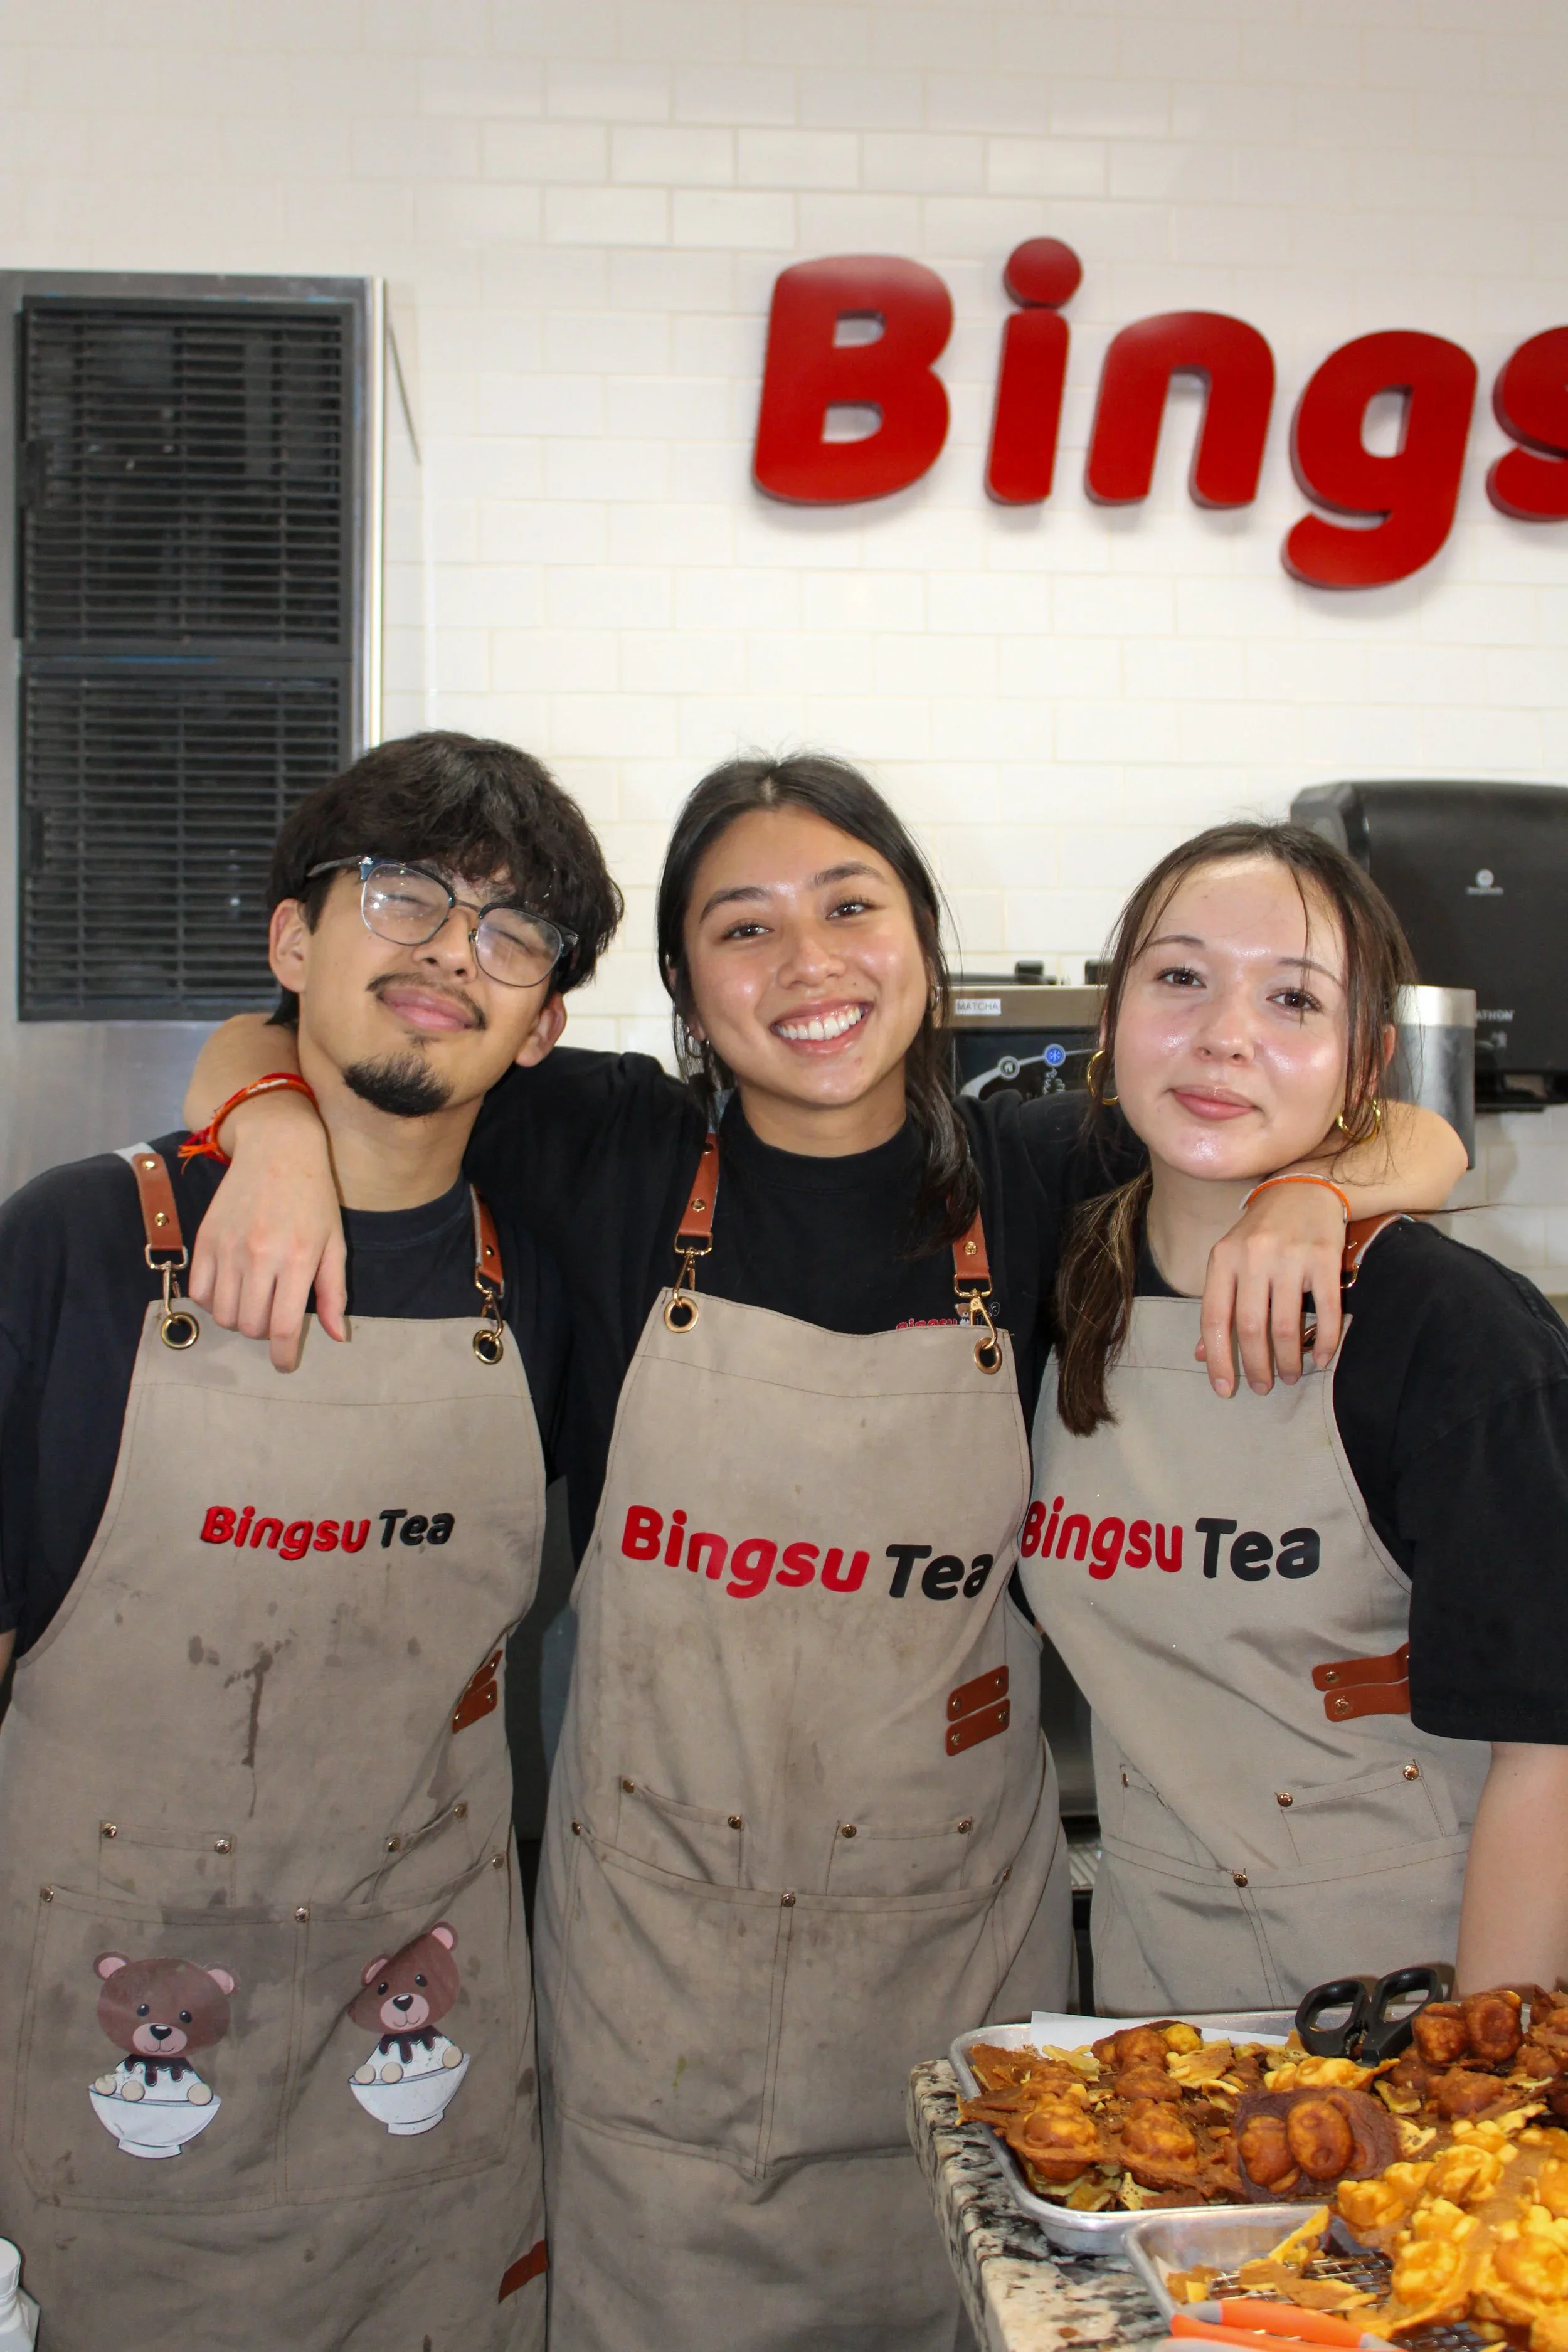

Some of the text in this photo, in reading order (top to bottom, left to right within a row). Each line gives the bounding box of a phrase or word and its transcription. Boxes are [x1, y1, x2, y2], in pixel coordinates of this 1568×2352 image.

[956, 1002, 999, 1011] MATCHA
[201, 1505, 455, 1560] Bingsu Tea
[621, 1505, 994, 1601] Bingsu Tea
[1021, 1496, 1321, 1582] Bingsu Tea
